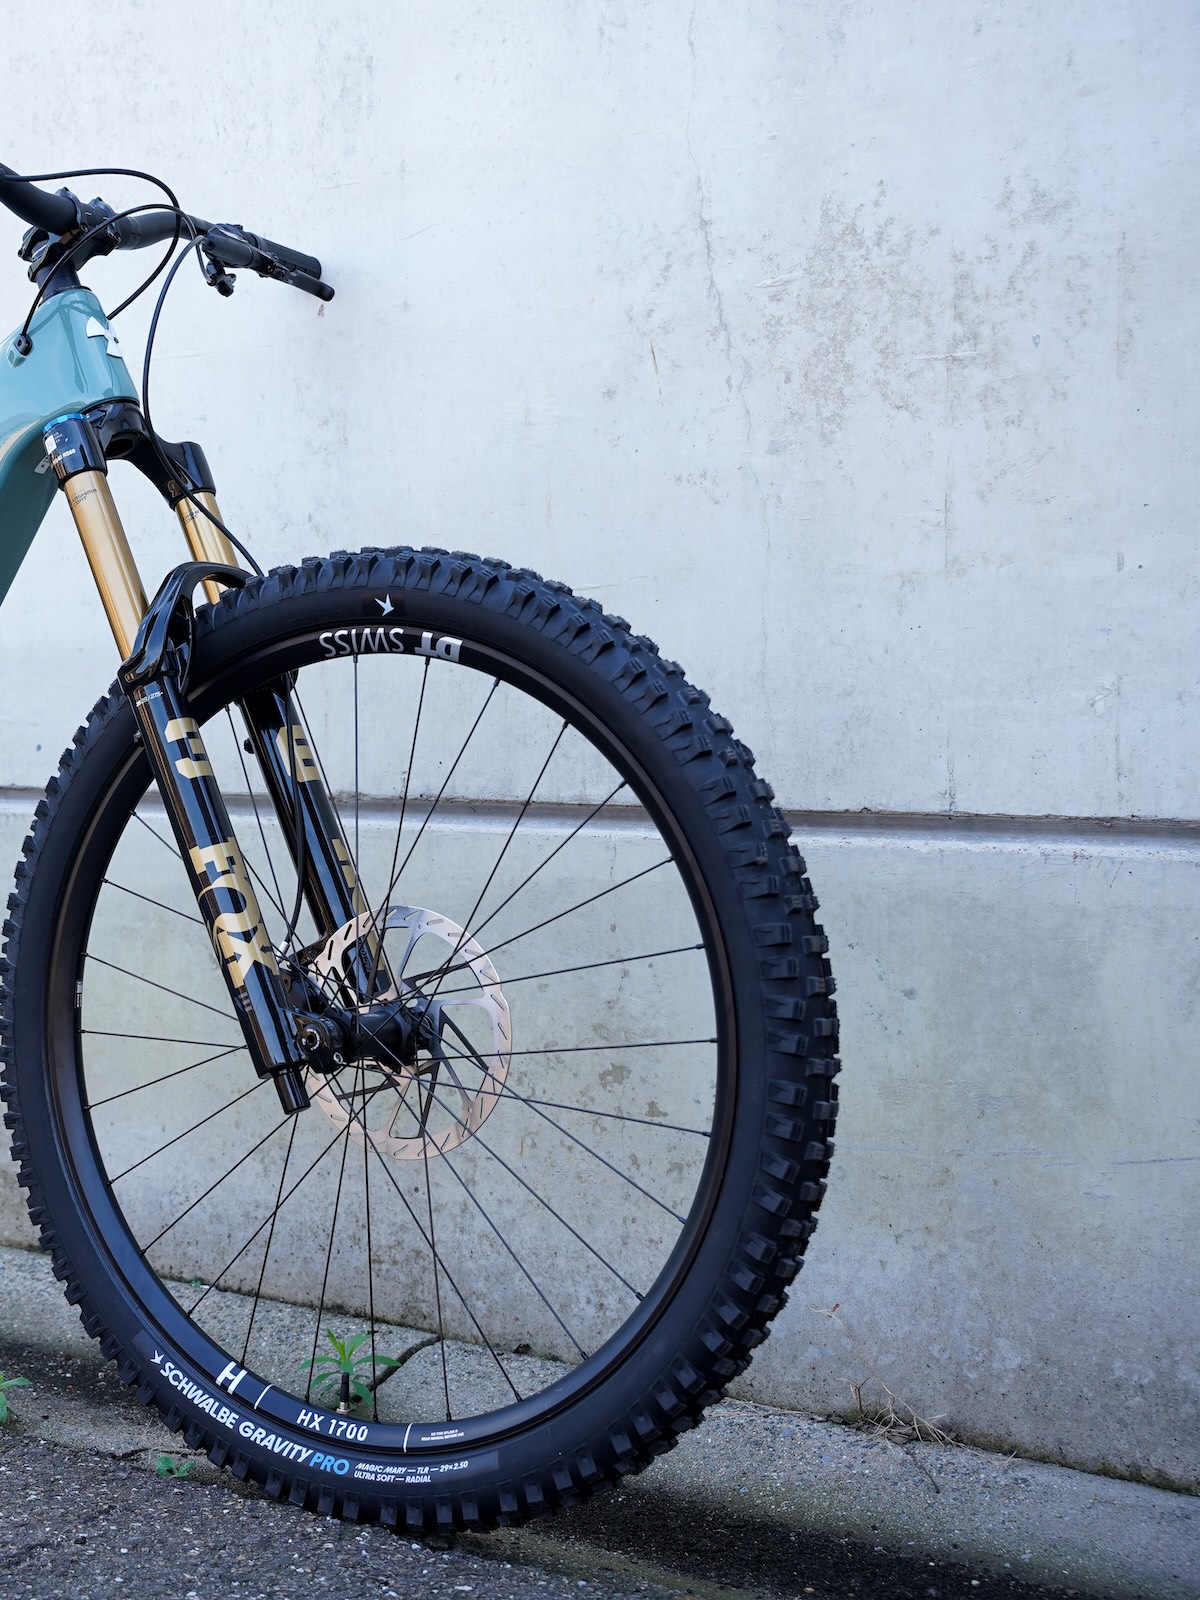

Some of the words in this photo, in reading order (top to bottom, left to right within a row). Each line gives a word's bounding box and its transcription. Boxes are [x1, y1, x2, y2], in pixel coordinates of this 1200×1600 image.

[319, 627, 404, 658] SWISS
[189, 836, 280, 988] FOX
[160, 1361, 240, 1430] SCHWALBE
[238, 1421, 313, 1463] GRAVITY
[309, 1452, 350, 1475] PRO
[296, 1409, 325, 1432] HX
[328, 1418, 369, 1442] 1700
[354, 1471, 376, 1481] ULTRA
[376, 1474, 395, 1483] SOFT
[405, 1475, 432, 1483] RADIAL
[355, 1463, 383, 1473] MAGIC
[383, 1466, 407, 1475] MARY
